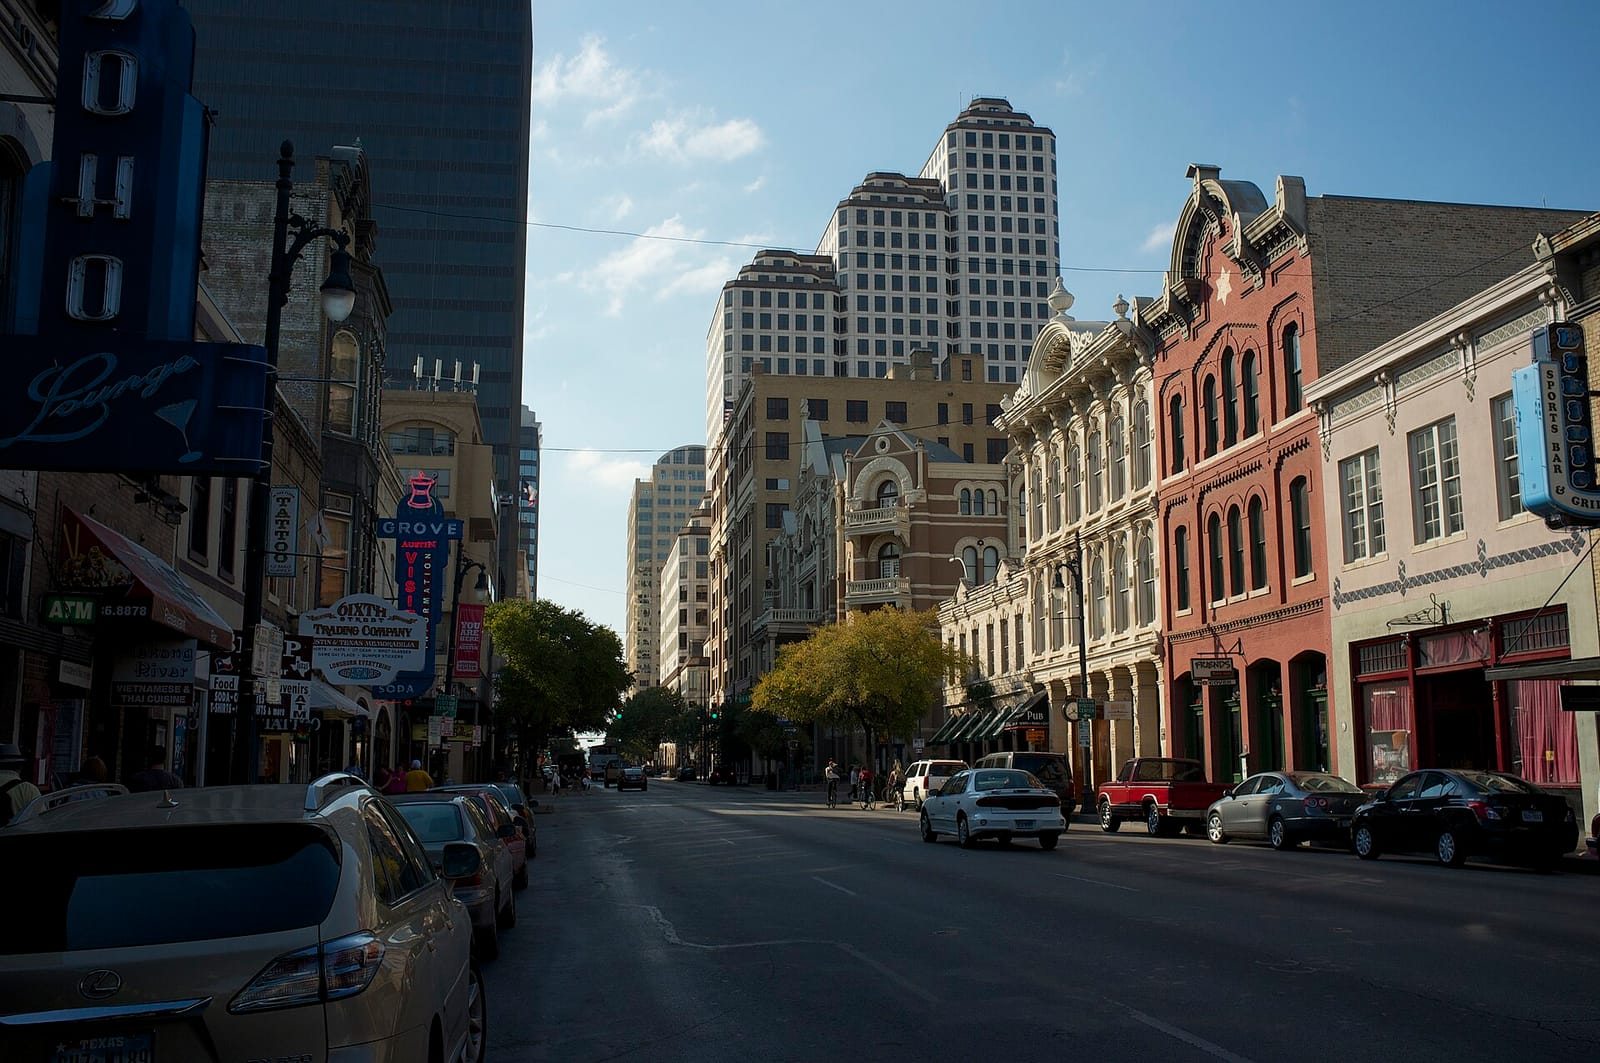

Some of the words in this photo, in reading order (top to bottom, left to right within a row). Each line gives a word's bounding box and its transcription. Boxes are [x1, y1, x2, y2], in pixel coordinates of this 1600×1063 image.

[0, 352, 200, 449] Lounge
[1546, 369, 1559, 434] SPORTS
[1552, 442, 1563, 474] BAR
[1555, 485, 1565, 495] &
[273, 496, 292, 563] TATTOO
[382, 521, 457, 535] GROVE
[400, 540, 438, 549] AUSTIN
[404, 551, 418, 614] VISI
[48, 601, 93, 620] ATM
[460, 621, 481, 630] YOU
[339, 639, 364, 647] TEXAS
[1195, 660, 1231, 669] FRIENDS
[116, 685, 181, 693] VIETNAMESE
[183, 685, 191, 693] &
[213, 677, 235, 689] Food
[378, 684, 414, 694] SODA
[121, 695, 145, 704] THAI
[146, 695, 187, 704] CUISINE
[214, 691, 230, 702] SODA
[293, 694, 306, 719] ATM
[263, 718, 321, 732] TATTO
[79, 1036, 124, 1050] TEXAS
